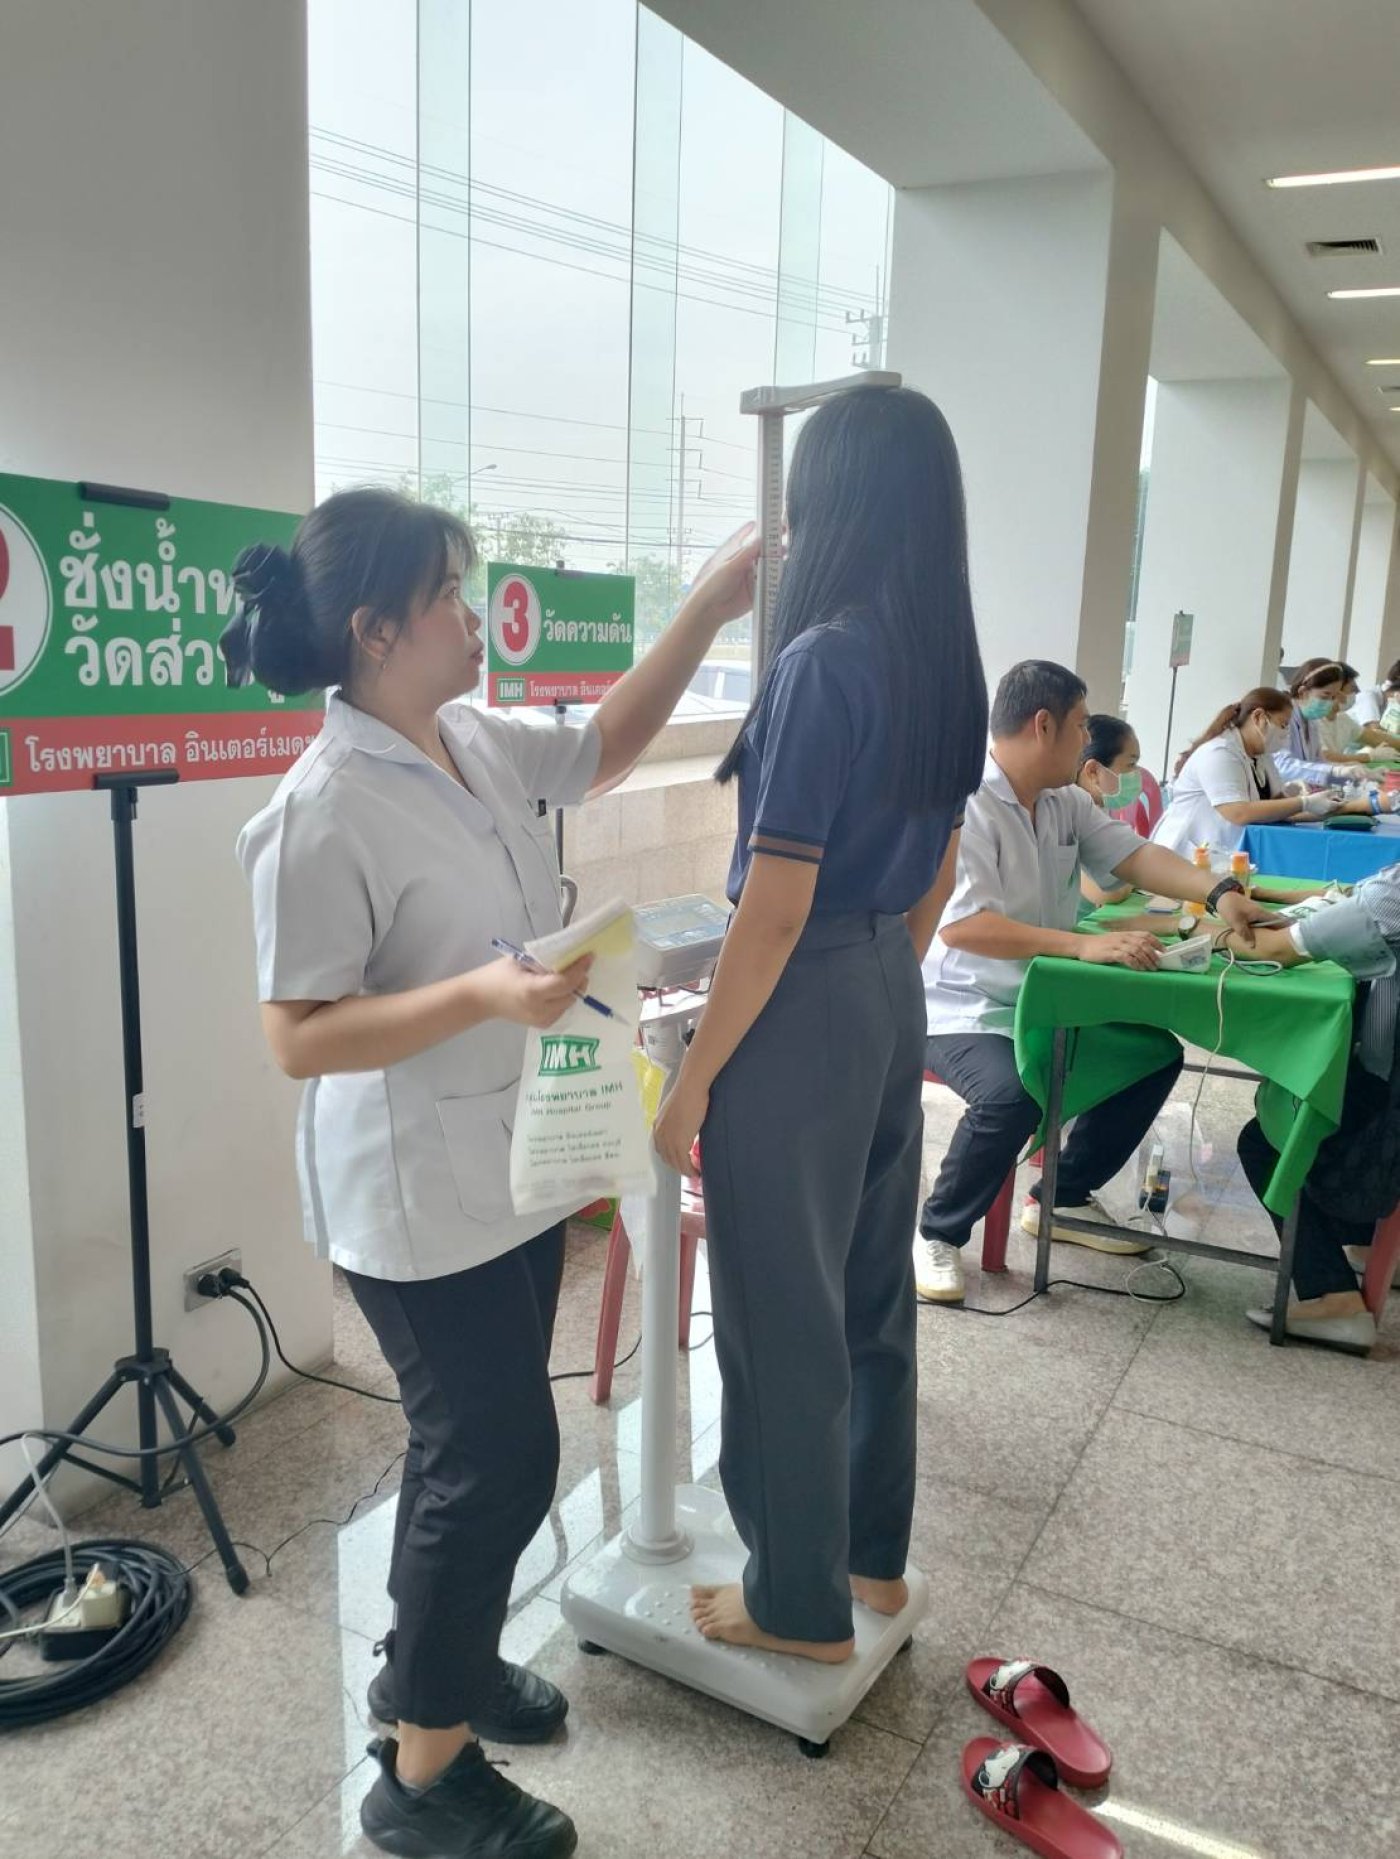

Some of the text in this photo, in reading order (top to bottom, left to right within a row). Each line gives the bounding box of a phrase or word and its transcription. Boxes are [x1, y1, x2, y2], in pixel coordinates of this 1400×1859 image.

[501, 580, 529, 652] 3
[543, 609, 632, 644] วัดความดัน
[64, 614, 254, 687] วัดส่ว
[500, 682, 523, 698] IMH
[25, 727, 316, 772] โรงพยาบาล อินเตอร์เมด
[543, 1042, 591, 1069] IMH
